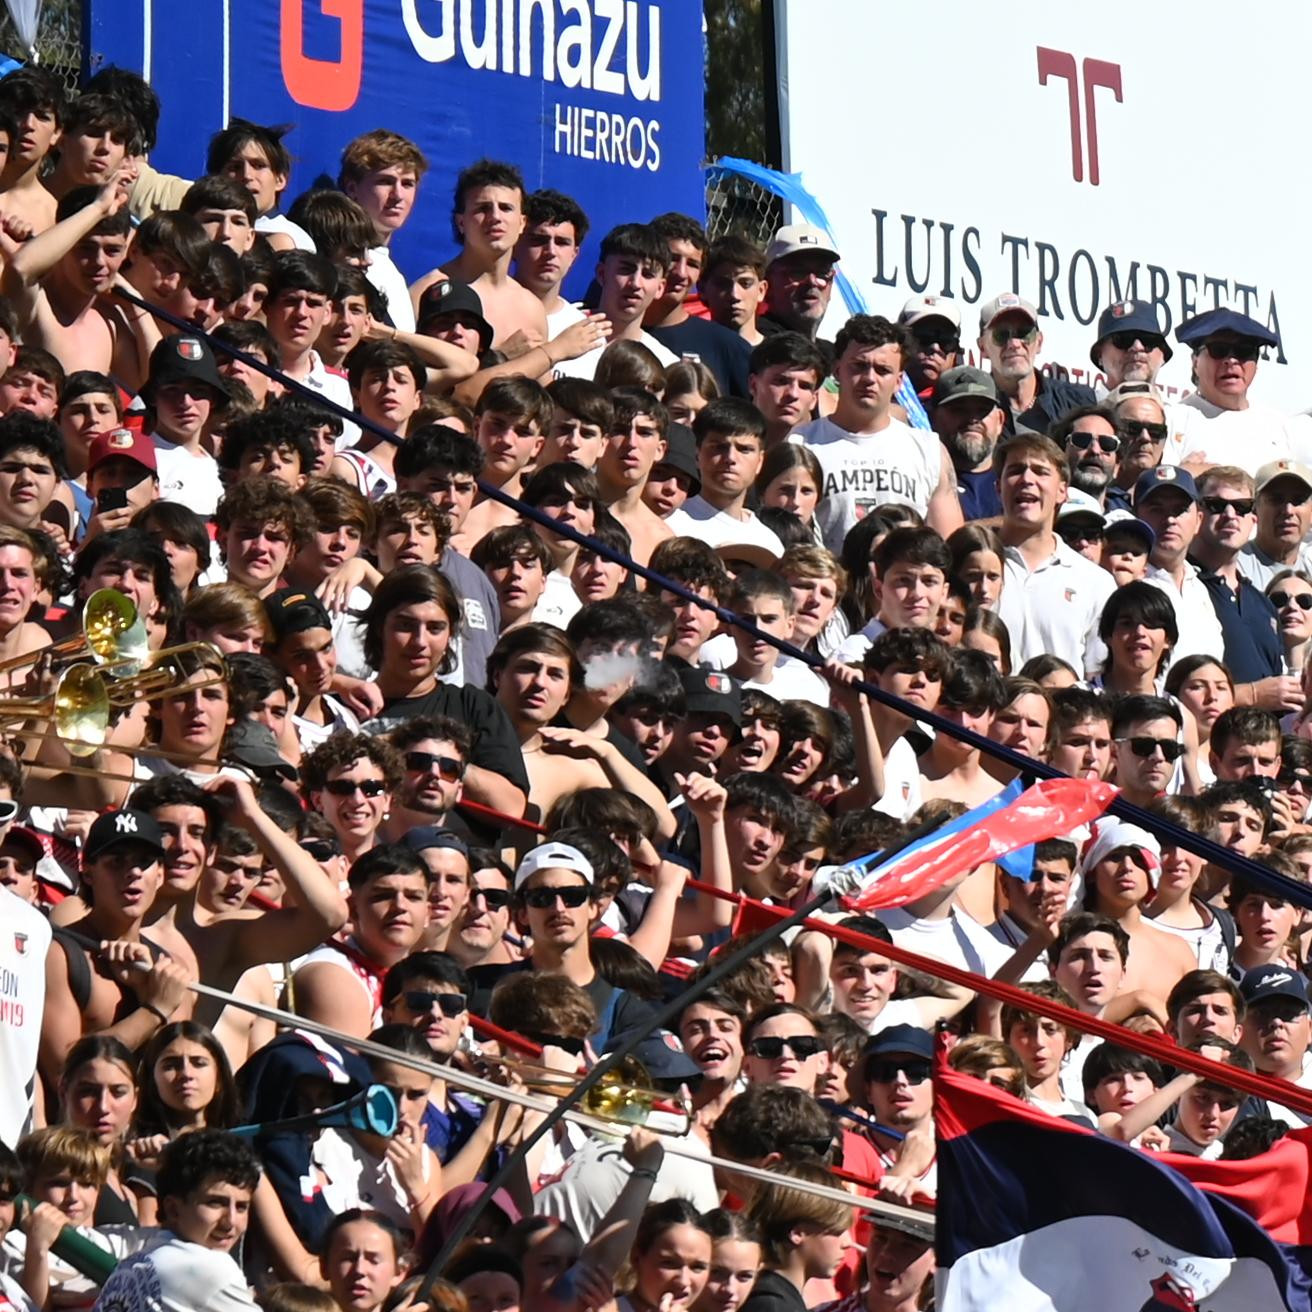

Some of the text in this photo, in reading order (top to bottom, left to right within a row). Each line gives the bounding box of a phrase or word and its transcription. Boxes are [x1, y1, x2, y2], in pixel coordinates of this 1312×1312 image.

[555, 103, 660, 171] HIERROS
[871, 208, 983, 304] LUIS
[826, 466, 918, 503] AMPEÓN
